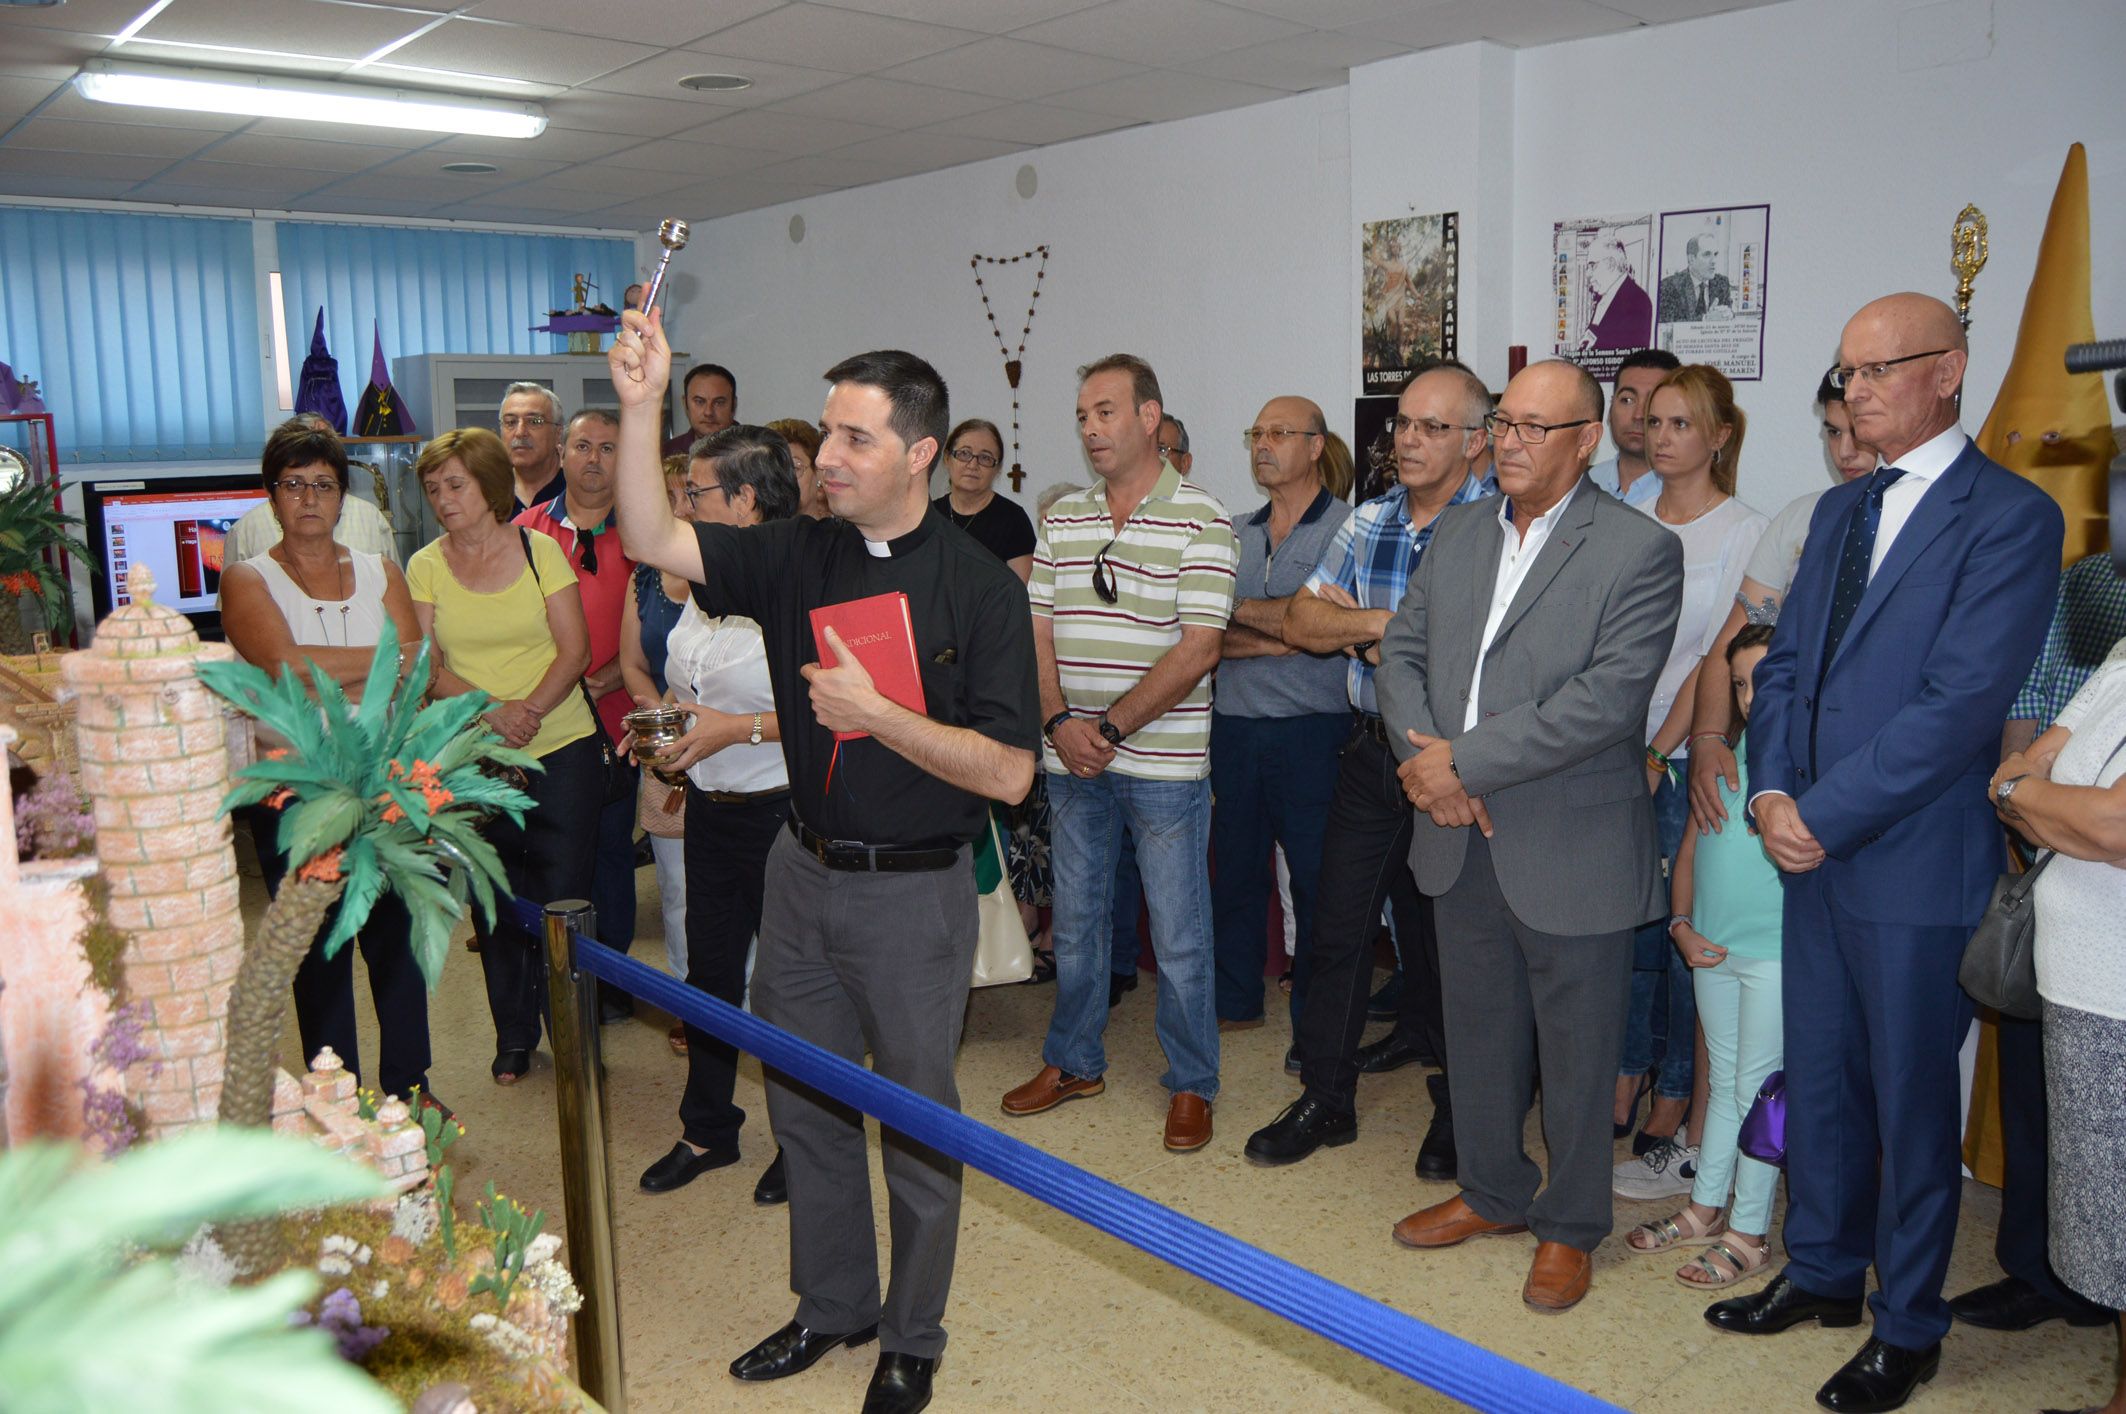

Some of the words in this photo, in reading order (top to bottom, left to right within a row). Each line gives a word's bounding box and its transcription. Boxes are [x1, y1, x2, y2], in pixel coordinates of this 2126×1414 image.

[1446, 216, 1456, 294] SEMANA
[1445, 300, 1454, 360] SANTA
[1595, 348, 1615, 356] Semana
[1615, 347, 1631, 355] Santa
[1580, 358, 1604, 366] ALFONSO
[1367, 372, 1379, 384] LAS
[1379, 370, 1403, 383] TORRES
[1729, 366, 1756, 374] MARÍN
[846, 631, 893, 647] DICIONAL
